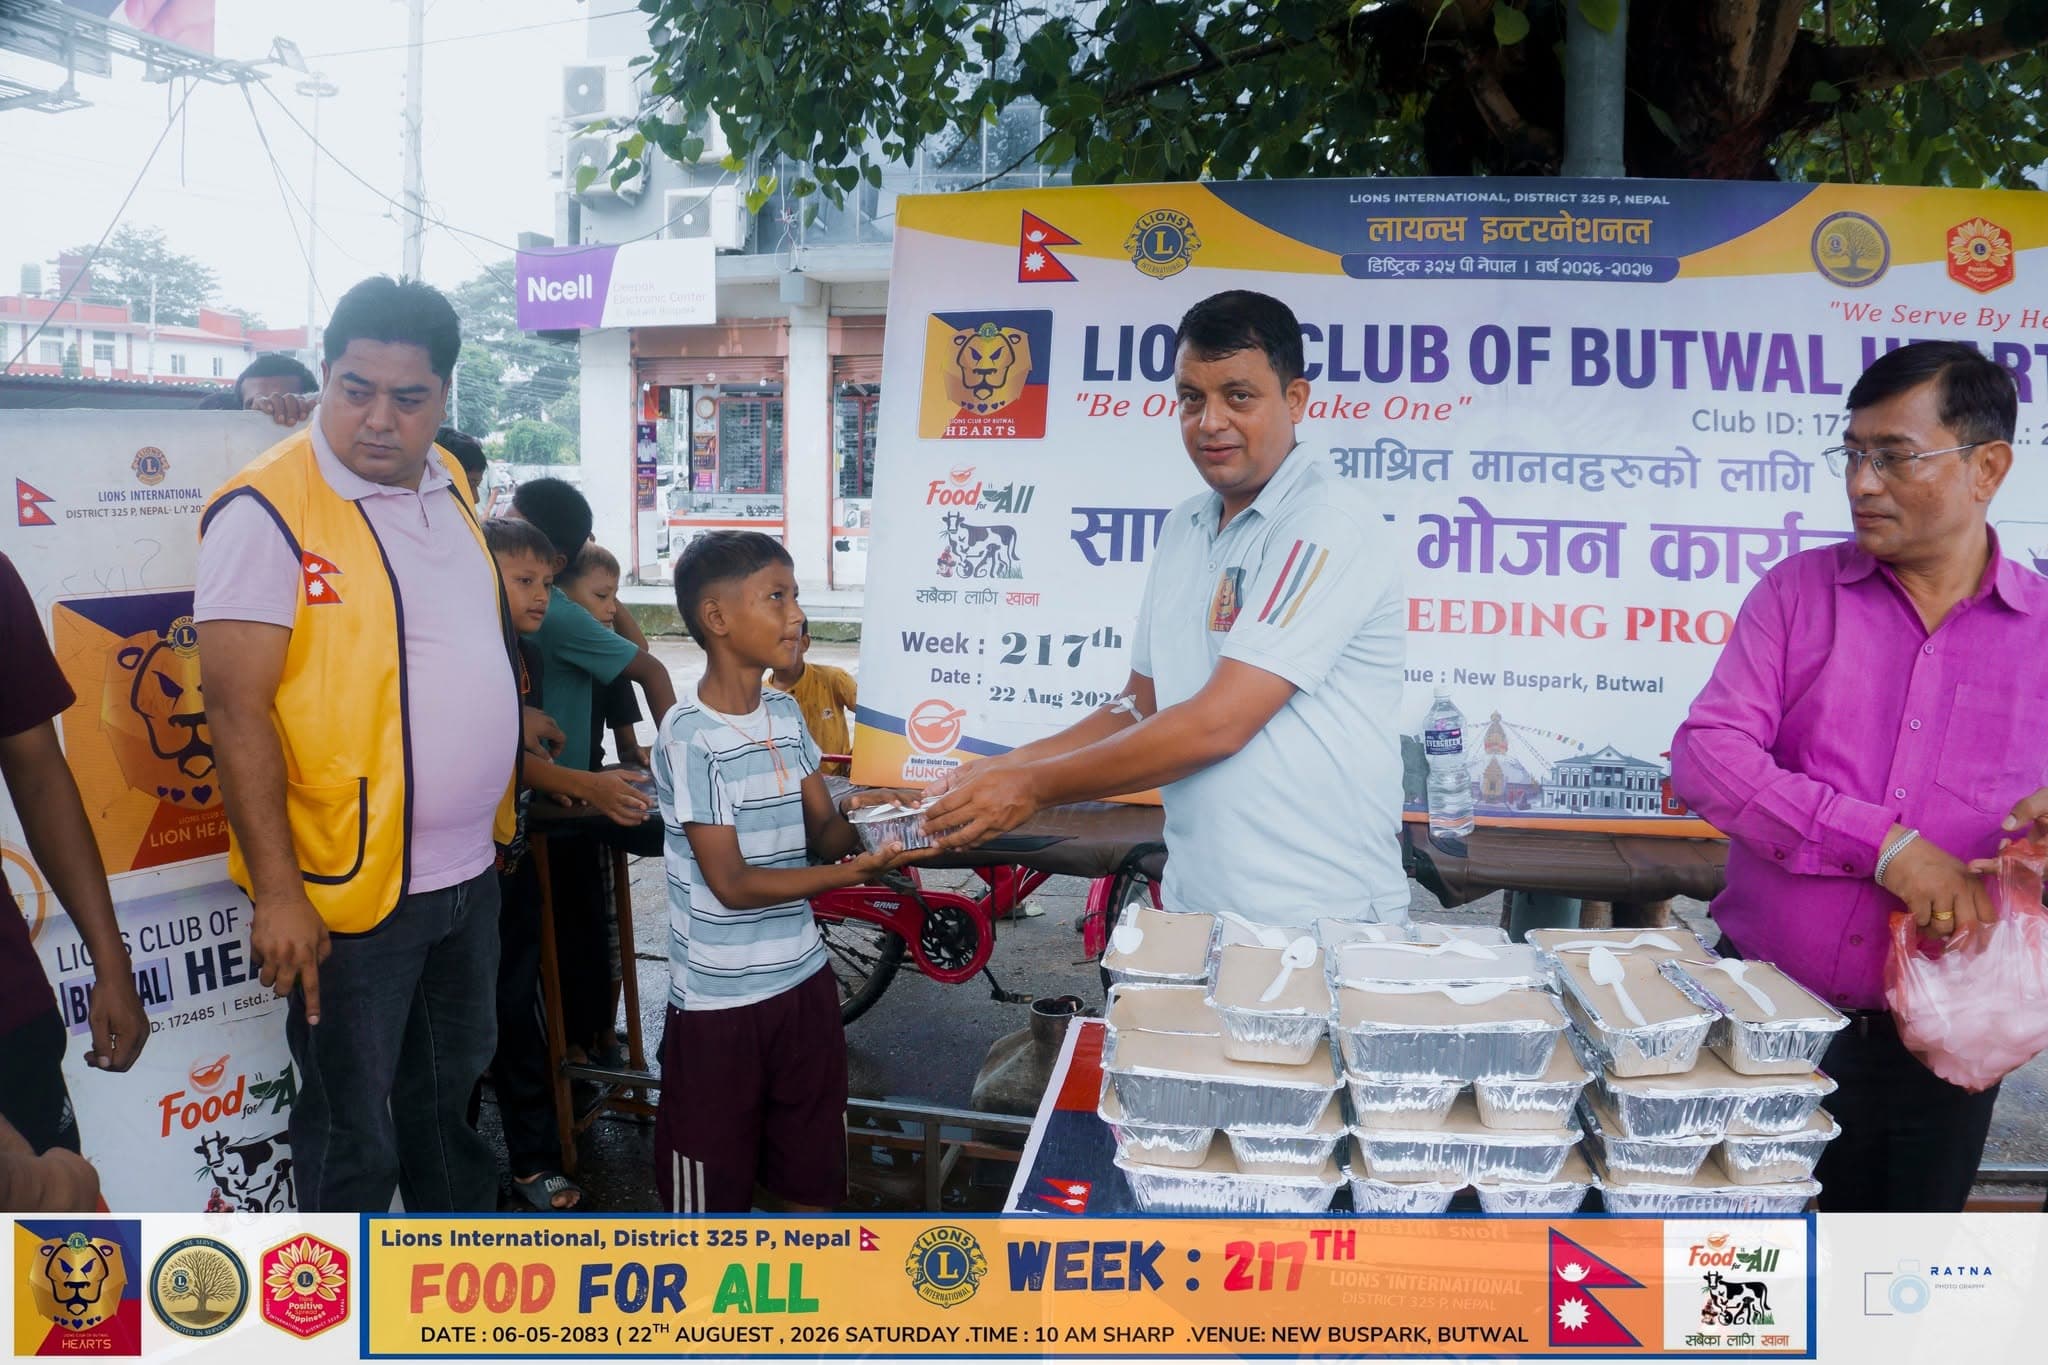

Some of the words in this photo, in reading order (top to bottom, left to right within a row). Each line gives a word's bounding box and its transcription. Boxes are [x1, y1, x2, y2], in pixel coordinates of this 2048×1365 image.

[1350, 193, 1391, 204] LIONS
[1394, 192, 1510, 204] INTERNATIONAL,
[1514, 193, 1577, 203] DISTRICT
[1582, 194, 1606, 204] 325
[1610, 195, 1621, 205] P,
[1625, 195, 1670, 205] NEPAL
[1142, 212, 1185, 227] LIONS
[1366, 216, 1468, 242] लायन्स
[1480, 209, 1653, 245] इन्टरनेशनल
[1154, 231, 1174, 255] L
[1424, 260, 1456, 275] ३२५
[1460, 256, 1474, 273] पी
[1477, 256, 1517, 273] नेपाल
[1536, 257, 1561, 274] वर्ष
[527, 274, 593, 303] Ncell
[1830, 301, 1883, 322] "We
[1891, 304, 1967, 326] Serve
[1977, 307, 2011, 333] By
[1083, 324, 1177, 382] LIO
[1300, 323, 1450, 384] CLUB
[1469, 324, 1551, 385] OF
[1571, 327, 1843, 395] BUTWAL
[1076, 393, 1130, 417] "Be
[1308, 394, 1371, 420] ake
[1384, 396, 1472, 421] One"
[945, 426, 1016, 436] HEARTS
[1692, 409, 1756, 432] Club
[1766, 411, 1803, 435] ID:
[146, 458, 156, 473] L
[1470, 446, 1701, 491] मानवहरूको
[1718, 450, 1815, 494] लागि
[98, 490, 126, 503] LIONS
[130, 488, 203, 501] INTERNATIONAL
[926, 480, 982, 506] Food
[993, 482, 1036, 514] All
[66, 508, 110, 519] DISTRICT
[111, 508, 129, 517] 325
[174, 505, 189, 514] L/Y
[1418, 497, 1626, 579] भोजन
[964, 588, 999, 605] लागि
[1006, 592, 1040, 607] खाना
[1406, 597, 1608, 640] EEDING
[1624, 606, 1734, 646] PRO
[182, 629, 194, 645] L
[901, 631, 970, 655] Week
[999, 626, 1122, 668] 217th
[931, 668, 971, 685] Date
[1453, 668, 1496, 686] New
[1503, 670, 1589, 692] Buspark,
[1596, 675, 1664, 693] Butwal
[989, 686, 1016, 702] 22
[1023, 688, 1064, 709] Aug
[150, 827, 190, 847] LION
[873, 901, 901, 910] GANG
[139, 916, 203, 953] CLUB
[210, 907, 239, 937] OF
[168, 1007, 215, 1029] 172485
[159, 1075, 246, 1138] Food
[241, 1104, 257, 1119] for
